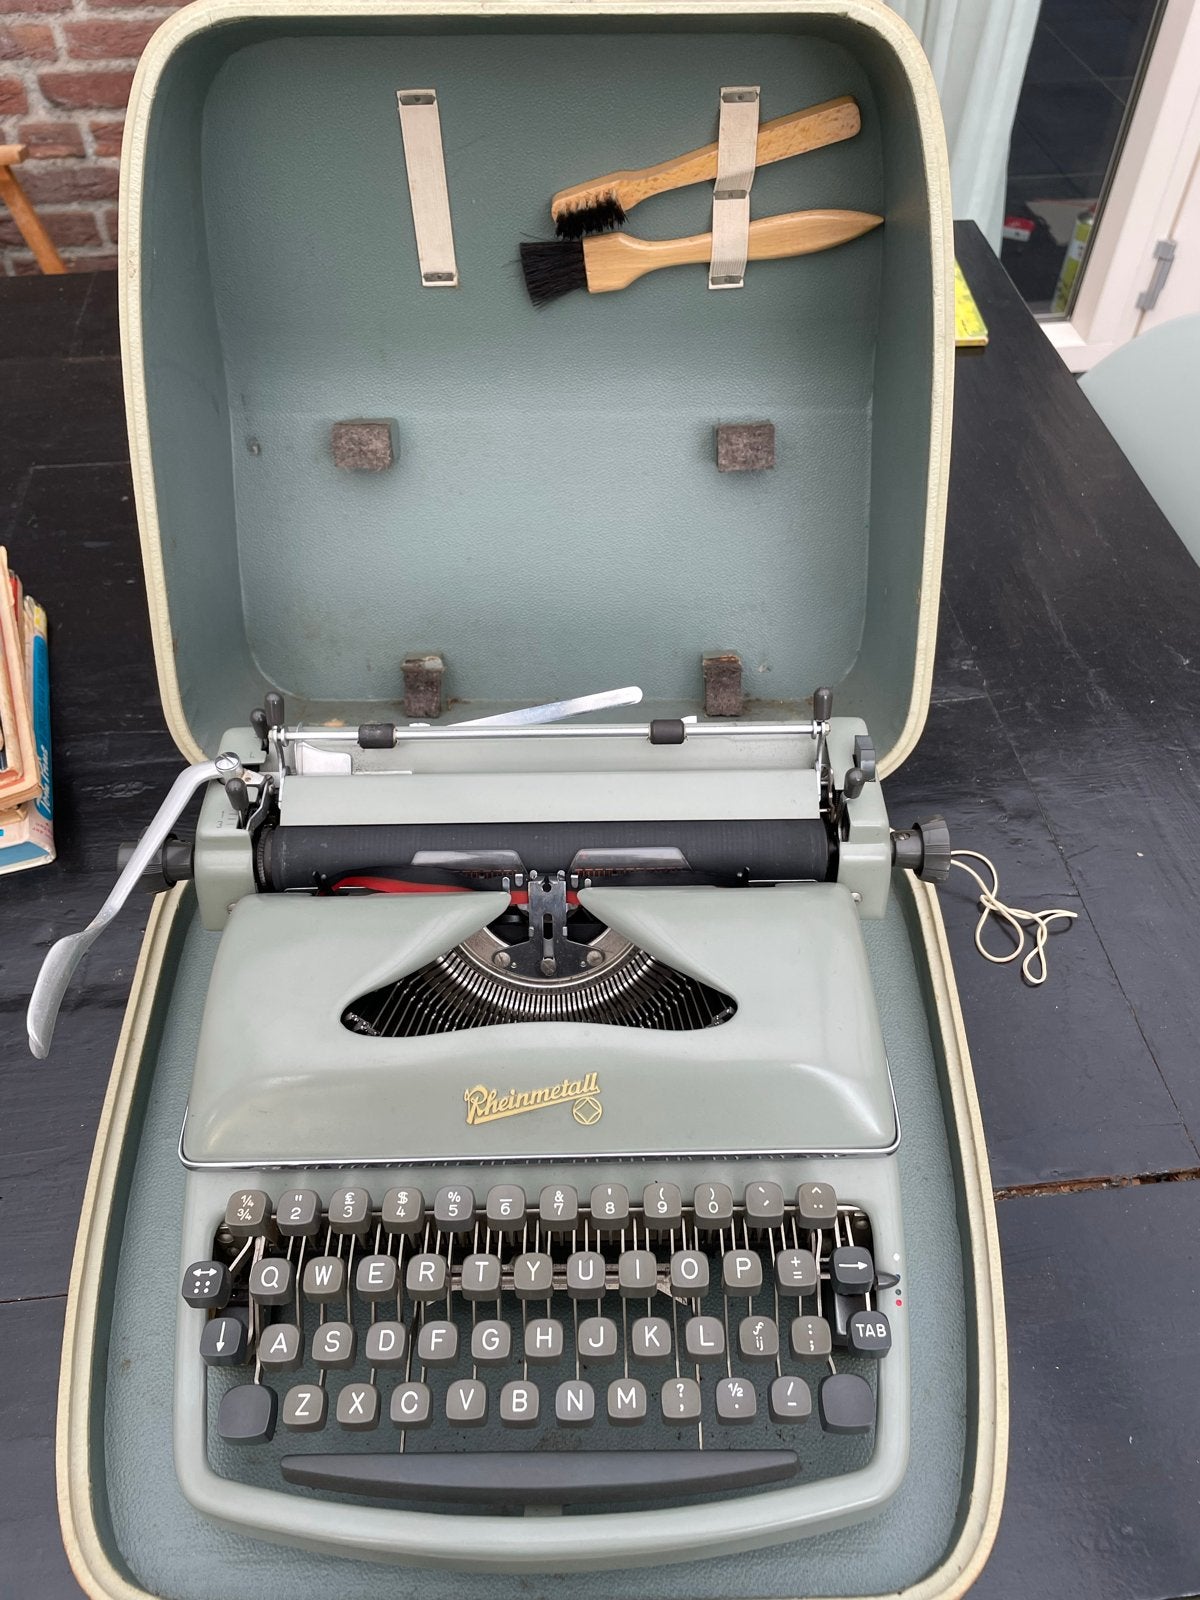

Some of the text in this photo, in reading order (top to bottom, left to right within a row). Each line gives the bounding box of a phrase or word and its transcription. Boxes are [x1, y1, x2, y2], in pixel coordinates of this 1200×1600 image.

[464, 1071, 601, 1125] Rheinmetall
[345, 1192, 354, 1204] £
[398, 1192, 408, 1204] $
[448, 1192, 460, 1202] %
[555, 1191, 563, 1202] &
[291, 1207, 301, 1219] 2
[343, 1206, 352, 1217] 3
[396, 1206, 405, 1217] 4
[449, 1205, 458, 1216] 5
[501, 1203, 510, 1215] 6
[554, 1203, 563, 1214] 7
[606, 1202, 615, 1214] 8
[658, 1201, 667, 1213] 9
[261, 1266, 278, 1288] Q
[316, 1265, 332, 1285] W
[369, 1263, 385, 1283] E
[419, 1262, 435, 1282] R
[475, 1262, 489, 1282] T
[527, 1261, 540, 1281] Y
[579, 1260, 593, 1280] U
[681, 1258, 698, 1279] O
[736, 1258, 751, 1278] P
[808, 1324, 812, 1334] :
[856, 1324, 886, 1337] TAB
[270, 1325, 714, 1353] A S D F G H J K L
[810, 1341, 814, 1351] ;
[677, 1384, 684, 1397] ?
[295, 1387, 636, 1415] Z X C V B N M
